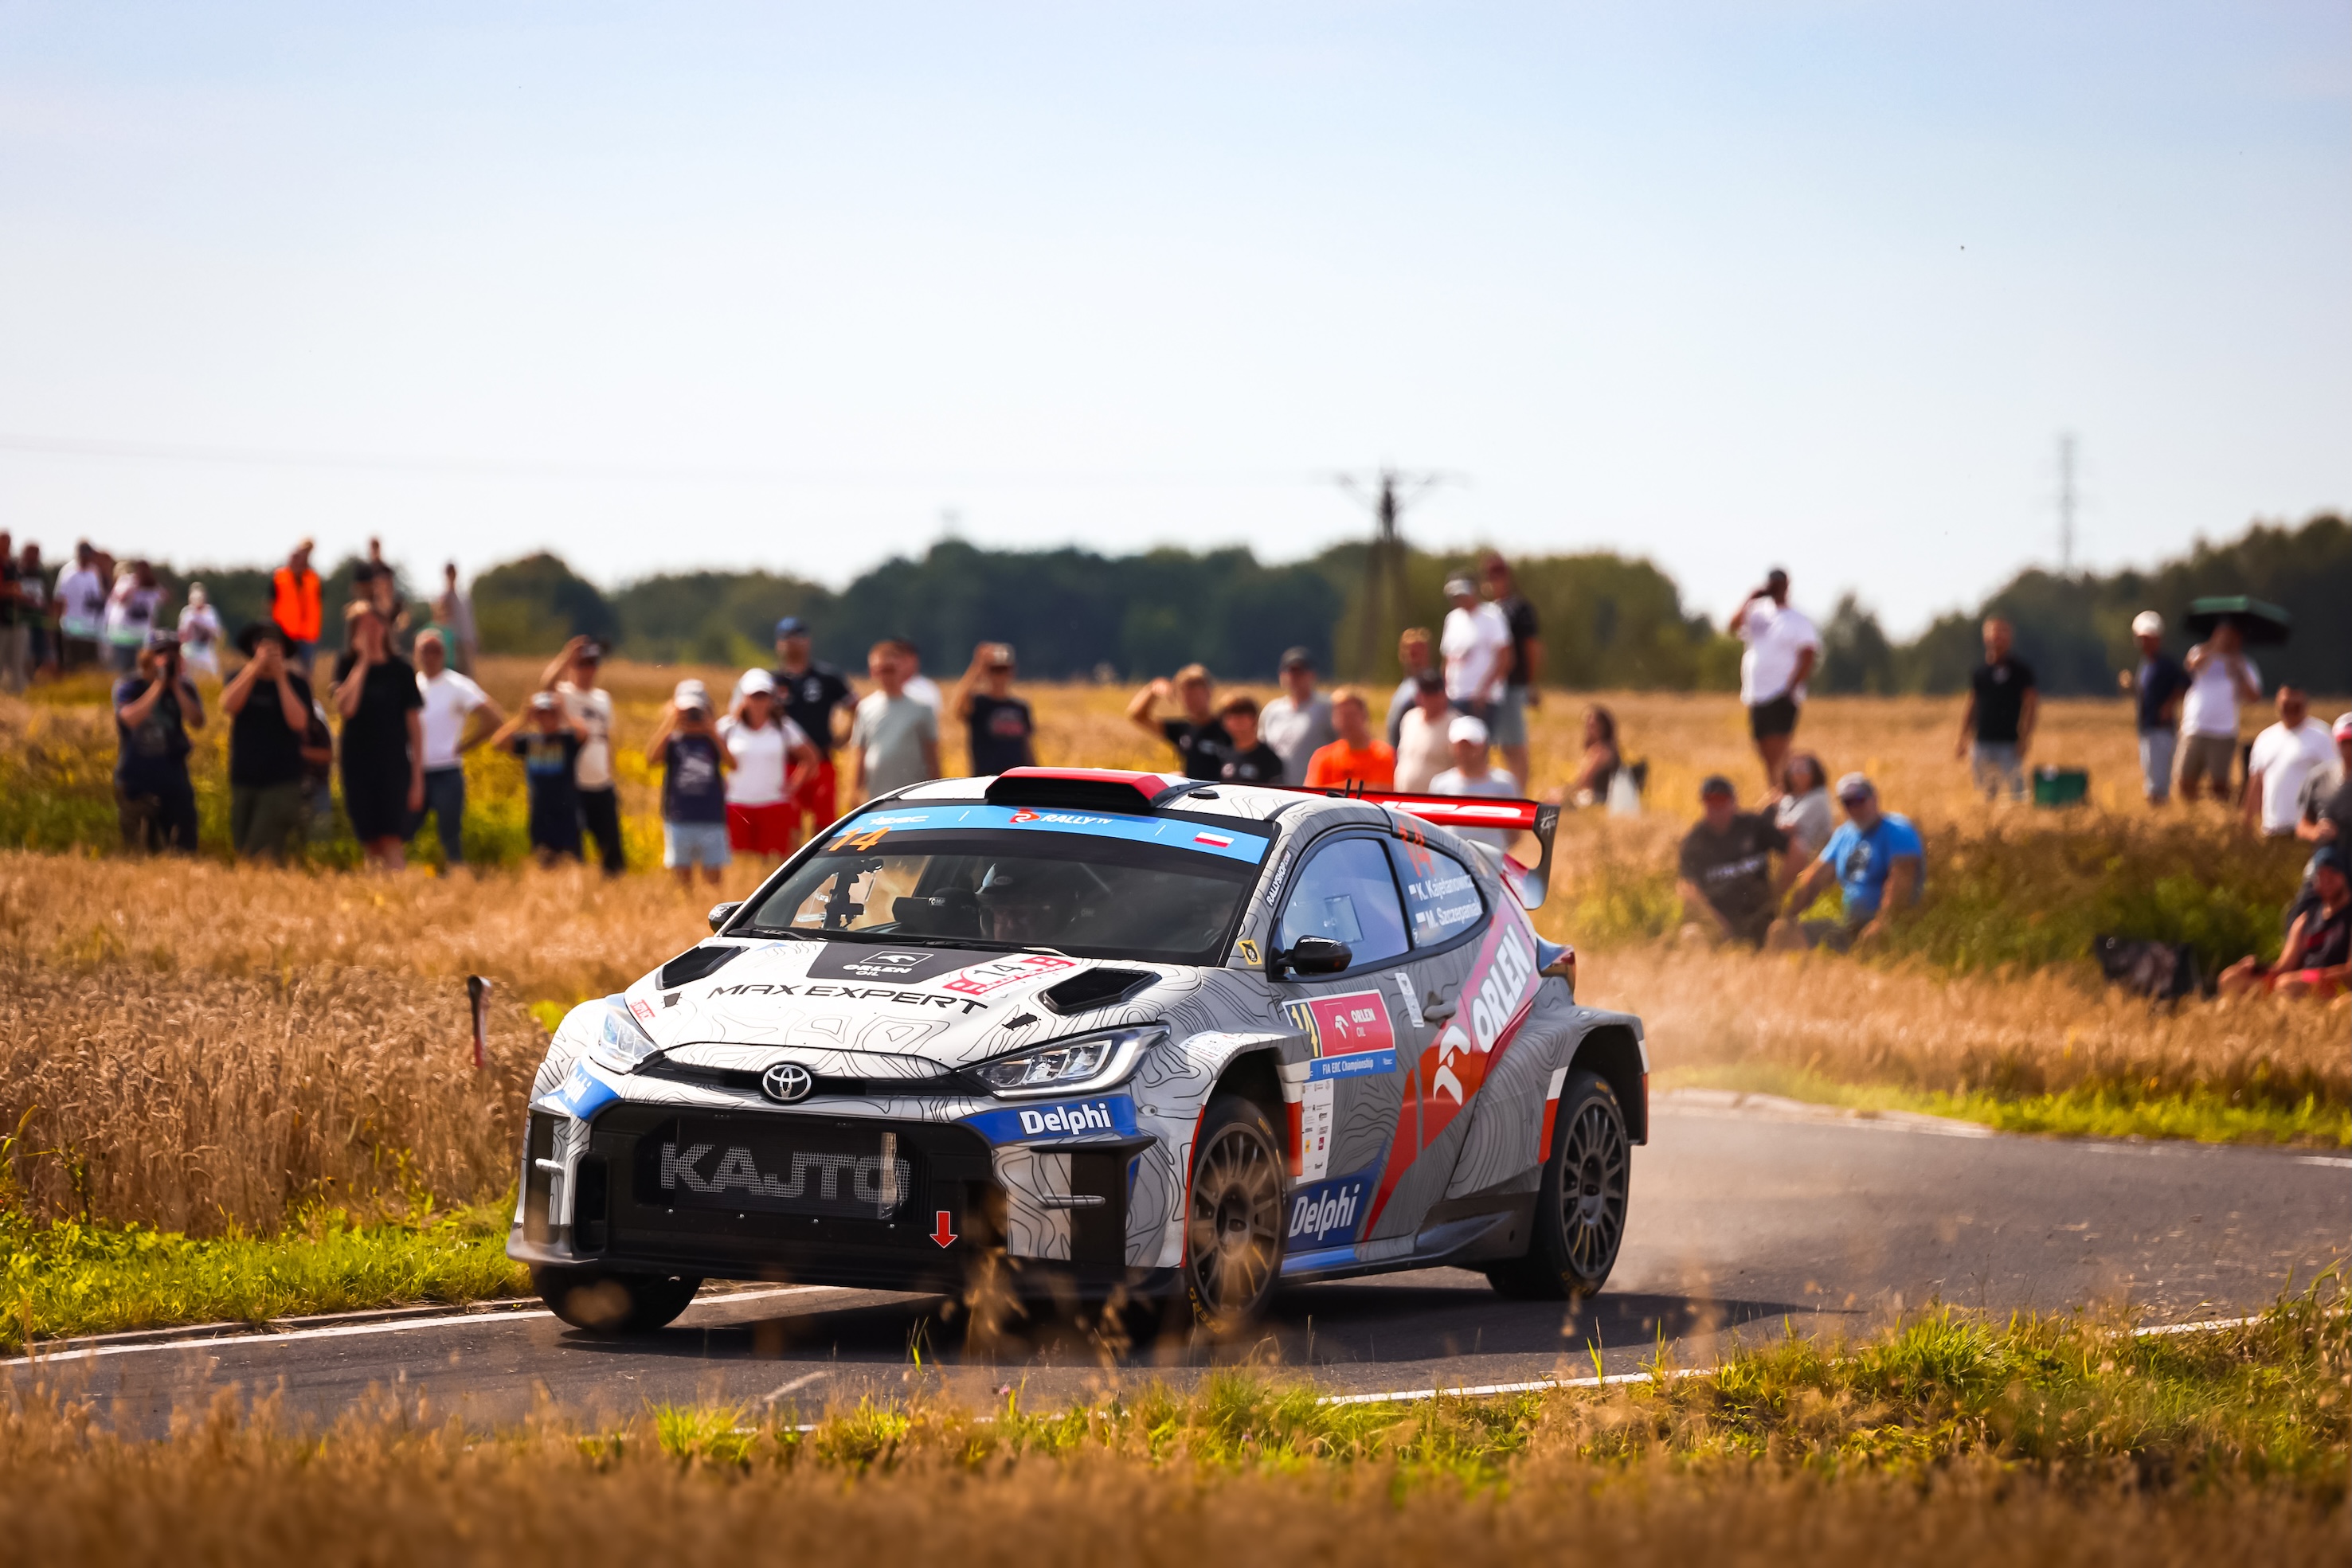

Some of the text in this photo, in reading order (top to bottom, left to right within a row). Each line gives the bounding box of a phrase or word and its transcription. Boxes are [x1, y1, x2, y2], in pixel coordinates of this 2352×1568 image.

[1040, 814, 1094, 824] RALLY
[828, 827, 892, 851] 14
[843, 964, 912, 974] ORLEN
[973, 964, 1026, 976] 14
[1473, 924, 1532, 1053] ORLEN
[707, 984, 802, 999] MAX
[804, 986, 988, 1015] EXPERT
[1351, 1008, 1376, 1023] ORLEN
[1356, 1026, 1366, 1037] OIL
[1322, 1064, 1331, 1074] FIA
[1332, 1062, 1341, 1073] ERC
[1342, 1058, 1374, 1073] Championship
[1019, 1103, 1111, 1135] Delphi
[661, 1142, 910, 1203] KAJTO
[1288, 1183, 1360, 1241] Delphi
